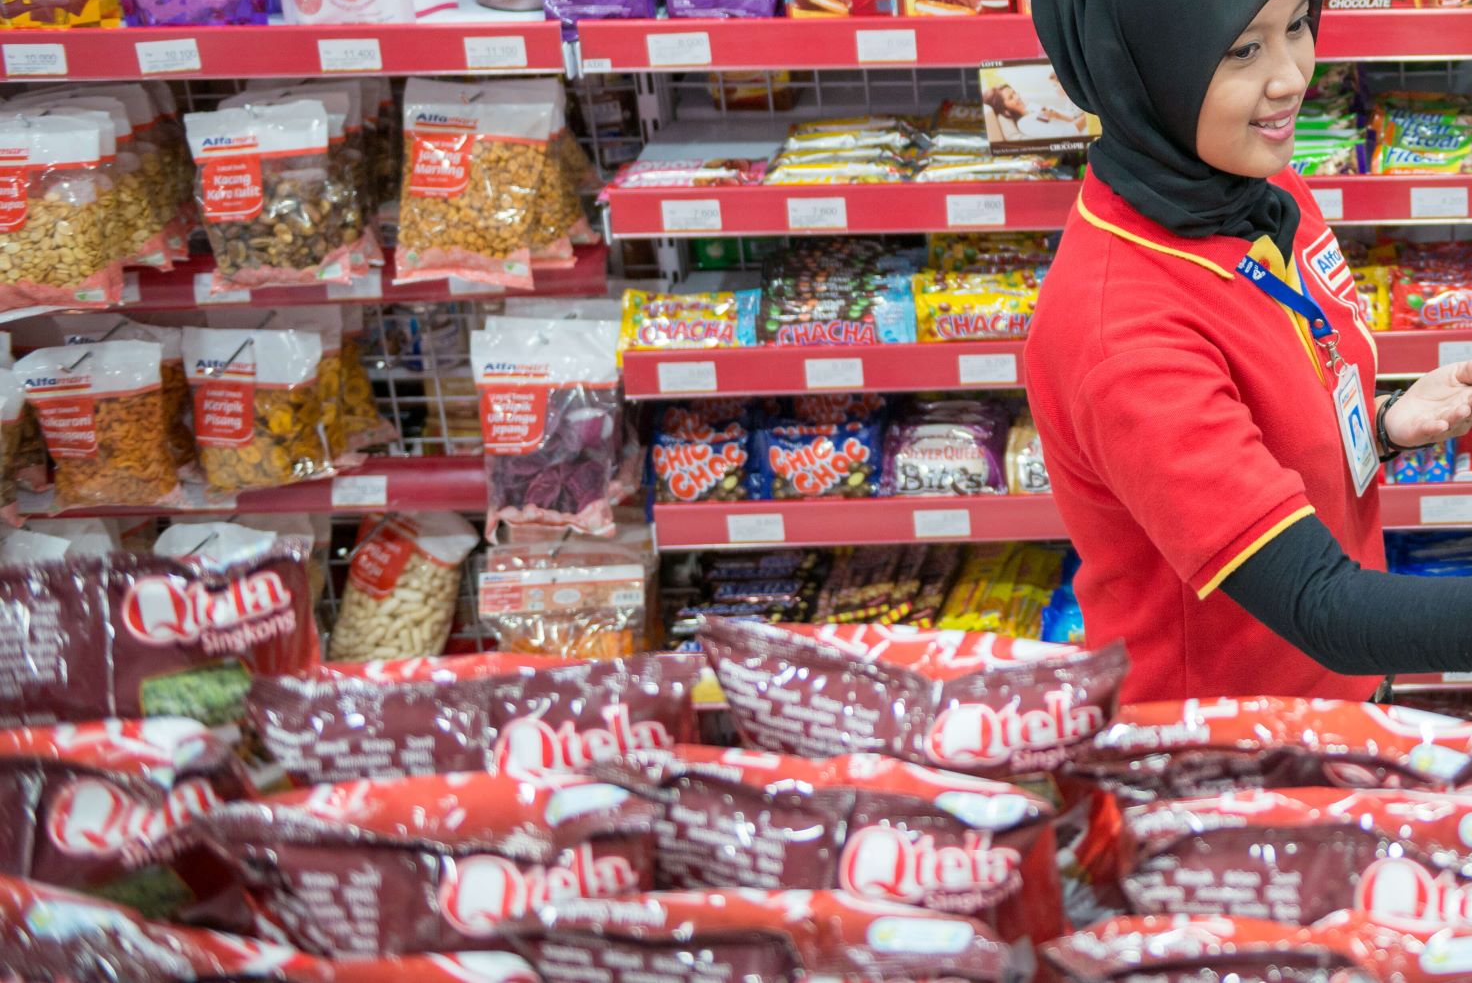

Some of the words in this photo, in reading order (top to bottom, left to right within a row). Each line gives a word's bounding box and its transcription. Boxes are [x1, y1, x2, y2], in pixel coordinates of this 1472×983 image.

[203, 135, 257, 147] Alfamart
[638, 320, 735, 346] CHACHA
[776, 319, 877, 346] CHACHA
[25, 374, 92, 387] Alfamart
[204, 399, 244, 415] Keripik
[204, 416, 242, 429] Pisang
[652, 442, 710, 474] CHIC
[667, 442, 749, 502] CHOC
[768, 435, 834, 474] CHIC
[792, 437, 871, 496] CHOC
[200, 609, 297, 655] Singkong
[492, 701, 674, 790] Qtela
[922, 690, 1104, 769] Qtela
[838, 824, 1022, 906] Qtela
